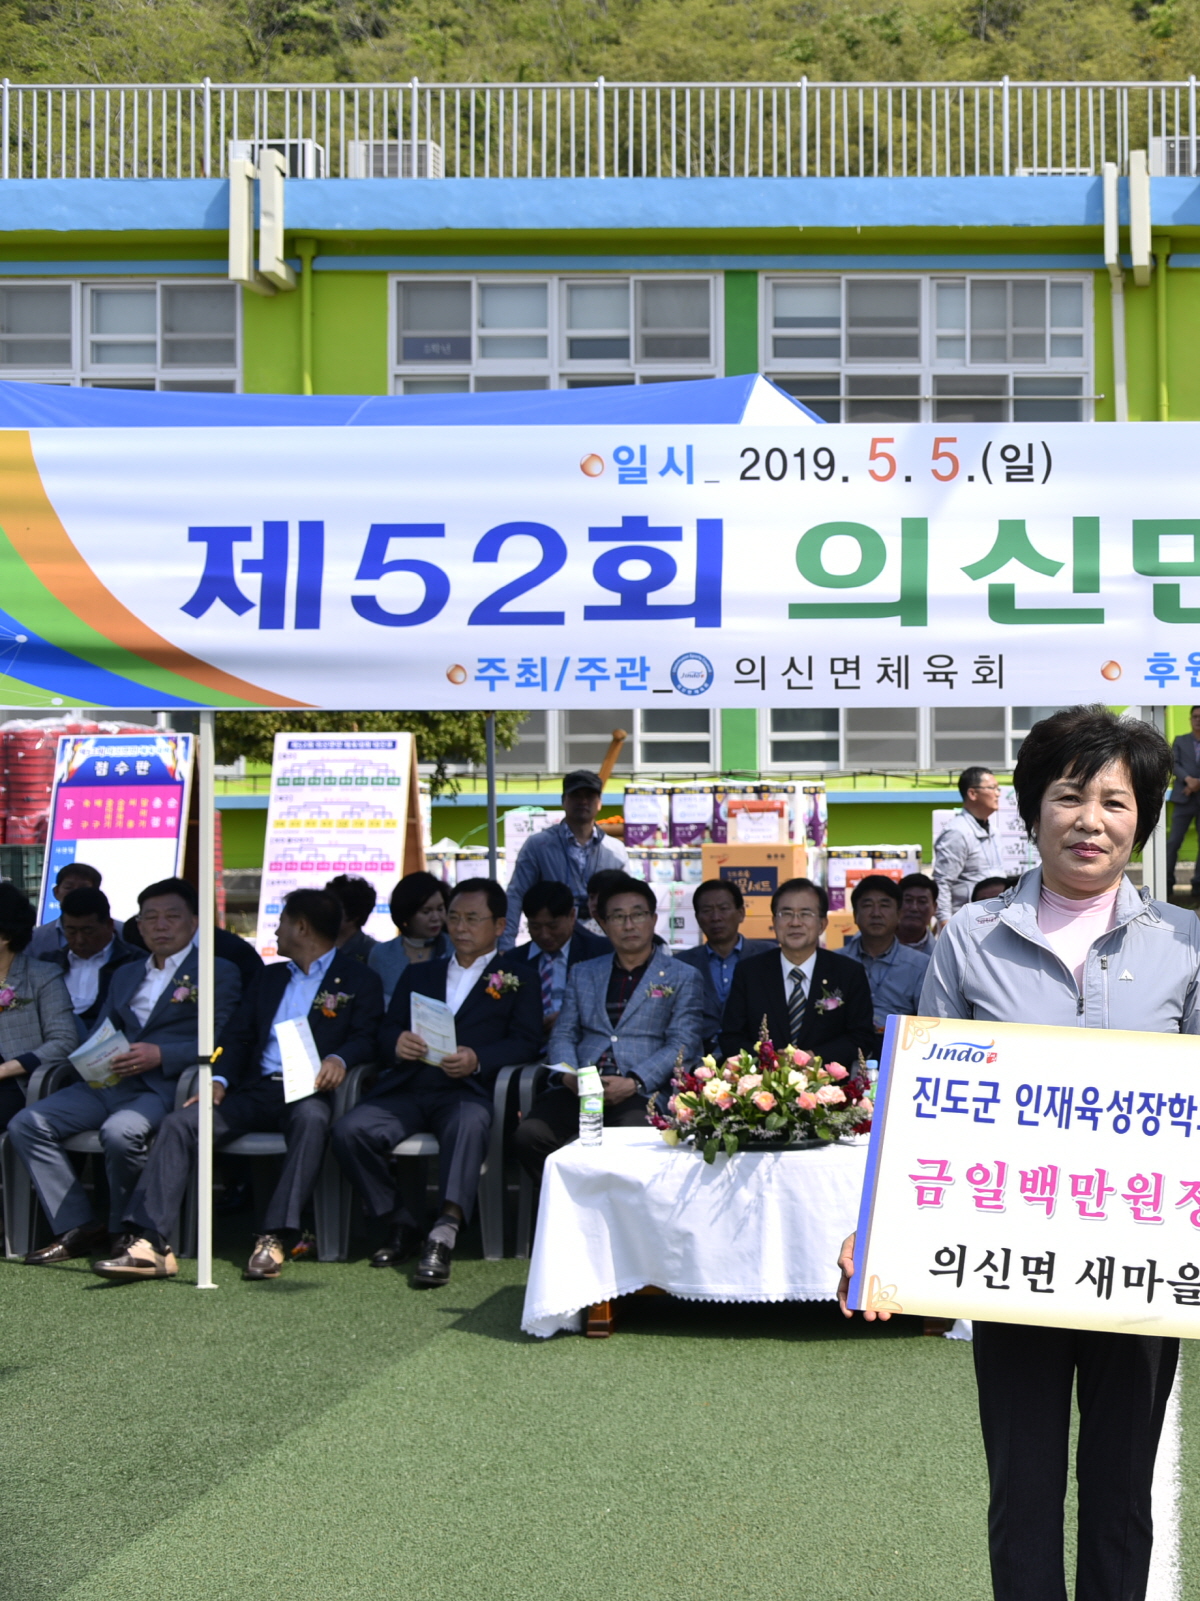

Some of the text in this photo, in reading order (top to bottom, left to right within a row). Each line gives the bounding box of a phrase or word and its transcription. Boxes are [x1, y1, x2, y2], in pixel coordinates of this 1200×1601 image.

[179, 515, 724, 630] 제52회
[922, 1043, 986, 1063] Jindo
[912, 1077, 1001, 1124] 진도군
[928, 1243, 1056, 1294] 의신면
